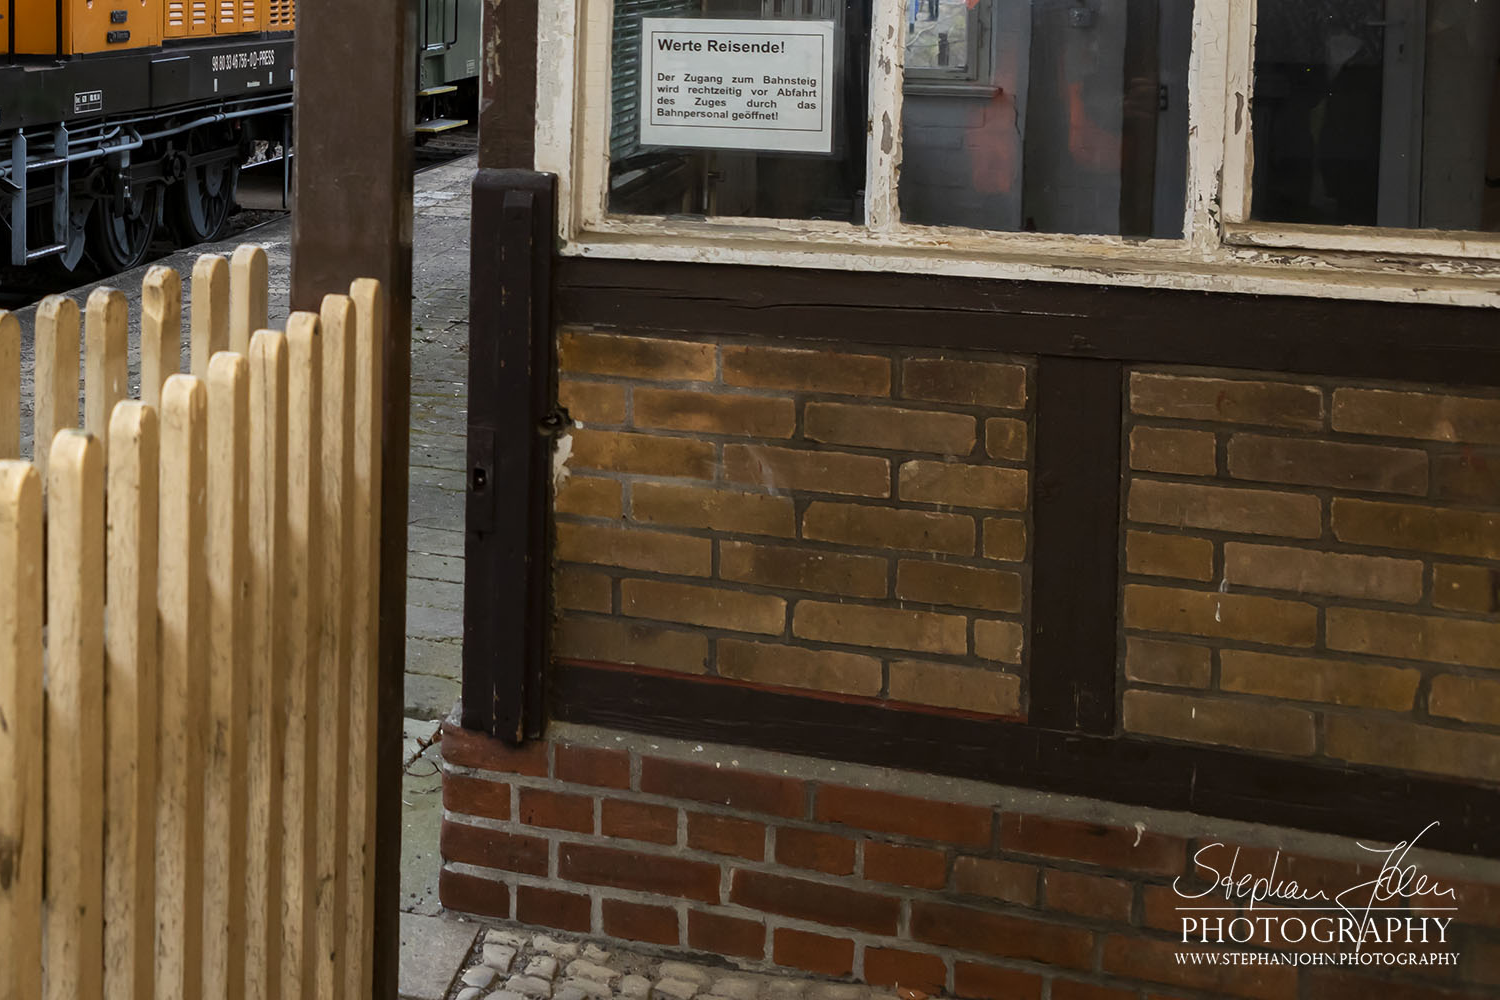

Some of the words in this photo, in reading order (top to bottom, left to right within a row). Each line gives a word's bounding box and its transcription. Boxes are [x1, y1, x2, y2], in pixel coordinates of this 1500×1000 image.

[657, 38, 702, 52] Werte
[707, 39, 785, 54] Reisende!
[657, 72, 675, 82] Der
[684, 73, 723, 84] Zugang
[731, 76, 754, 84] zum
[763, 75, 817, 87] Bahnsteig
[657, 85, 679, 94] wird
[687, 86, 742, 97] rechtzeitig
[751, 89, 768, 97] vor
[777, 88, 817, 98] Abfahrt
[657, 97, 675, 106] des
[694, 97, 727, 108] Zuges
[746, 99, 777, 109] durch
[797, 101, 817, 110] das
[657, 107, 729, 120] Bahnpersonal
[731, 110, 779, 121] geöffnet!
